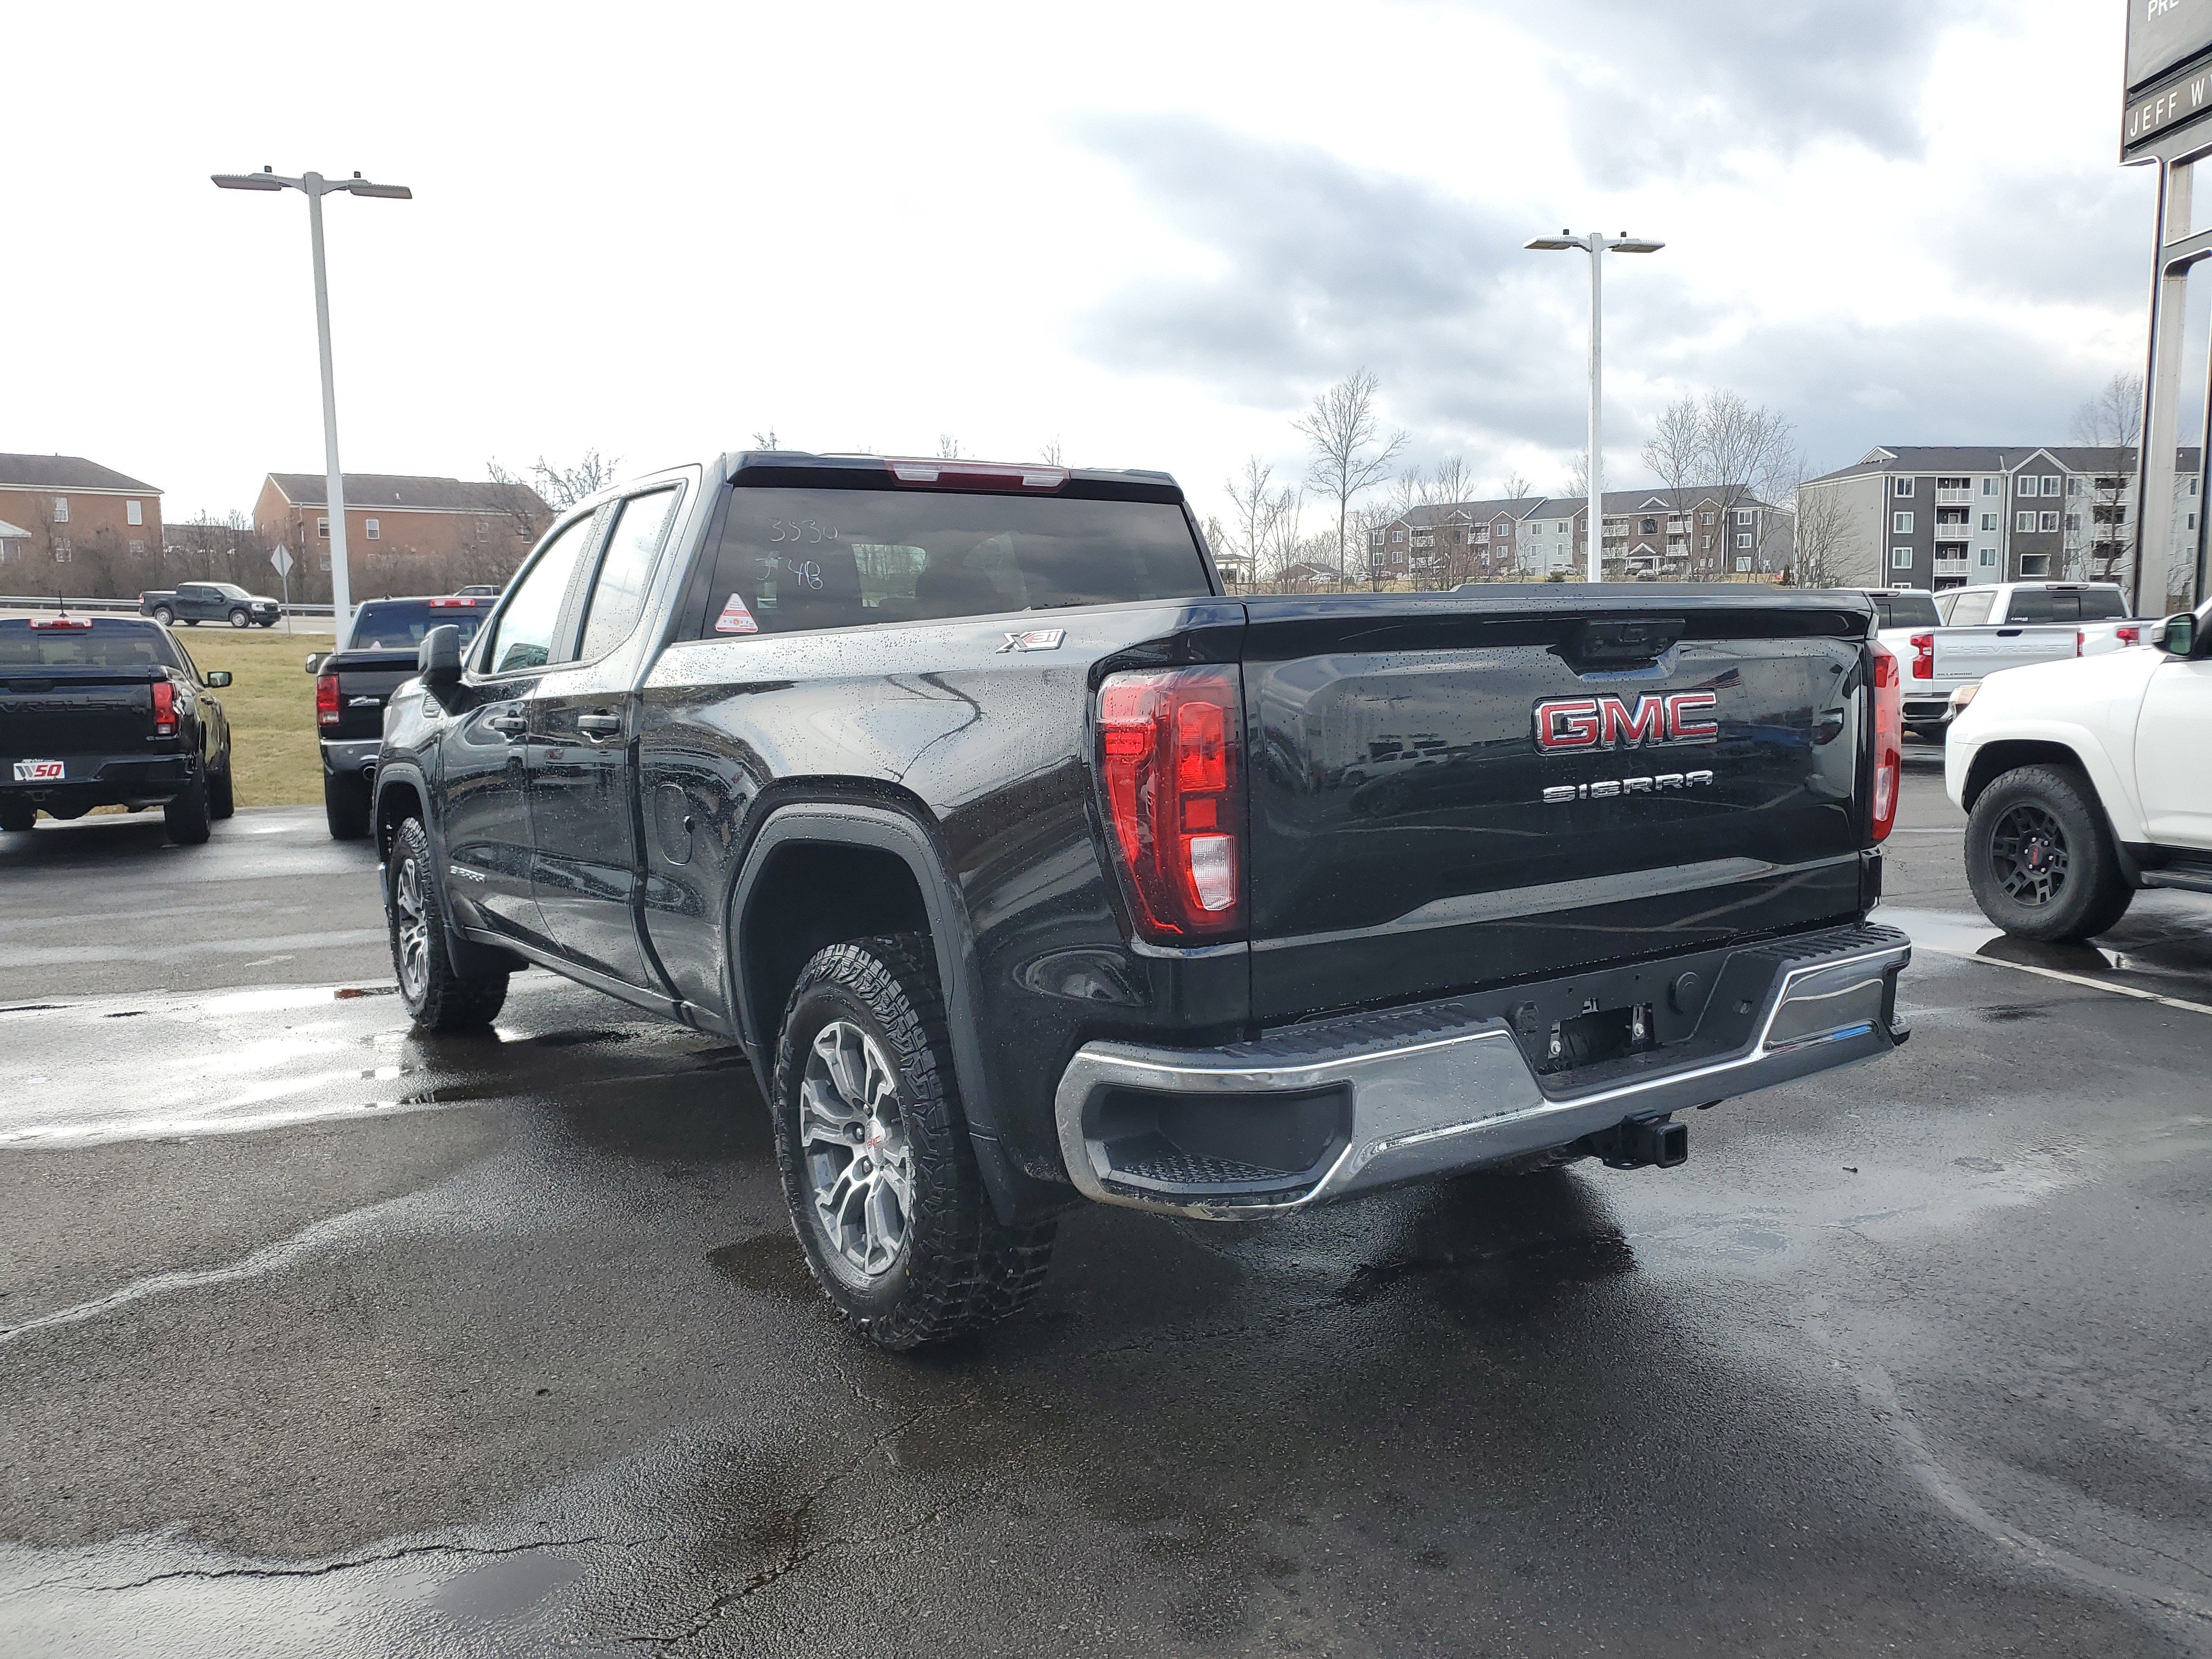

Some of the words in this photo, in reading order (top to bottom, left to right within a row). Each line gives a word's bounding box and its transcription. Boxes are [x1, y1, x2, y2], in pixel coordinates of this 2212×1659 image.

[2130, 92, 2177, 137] JEFF
[2191, 74, 2212, 107] W
[995, 628, 1067, 654] X31
[1945, 644, 2070, 655] CHEVROLET
[1534, 691, 1719, 752] GMC
[1543, 769, 1714, 804] SIERRA
[867, 1135, 882, 1149] GMC
